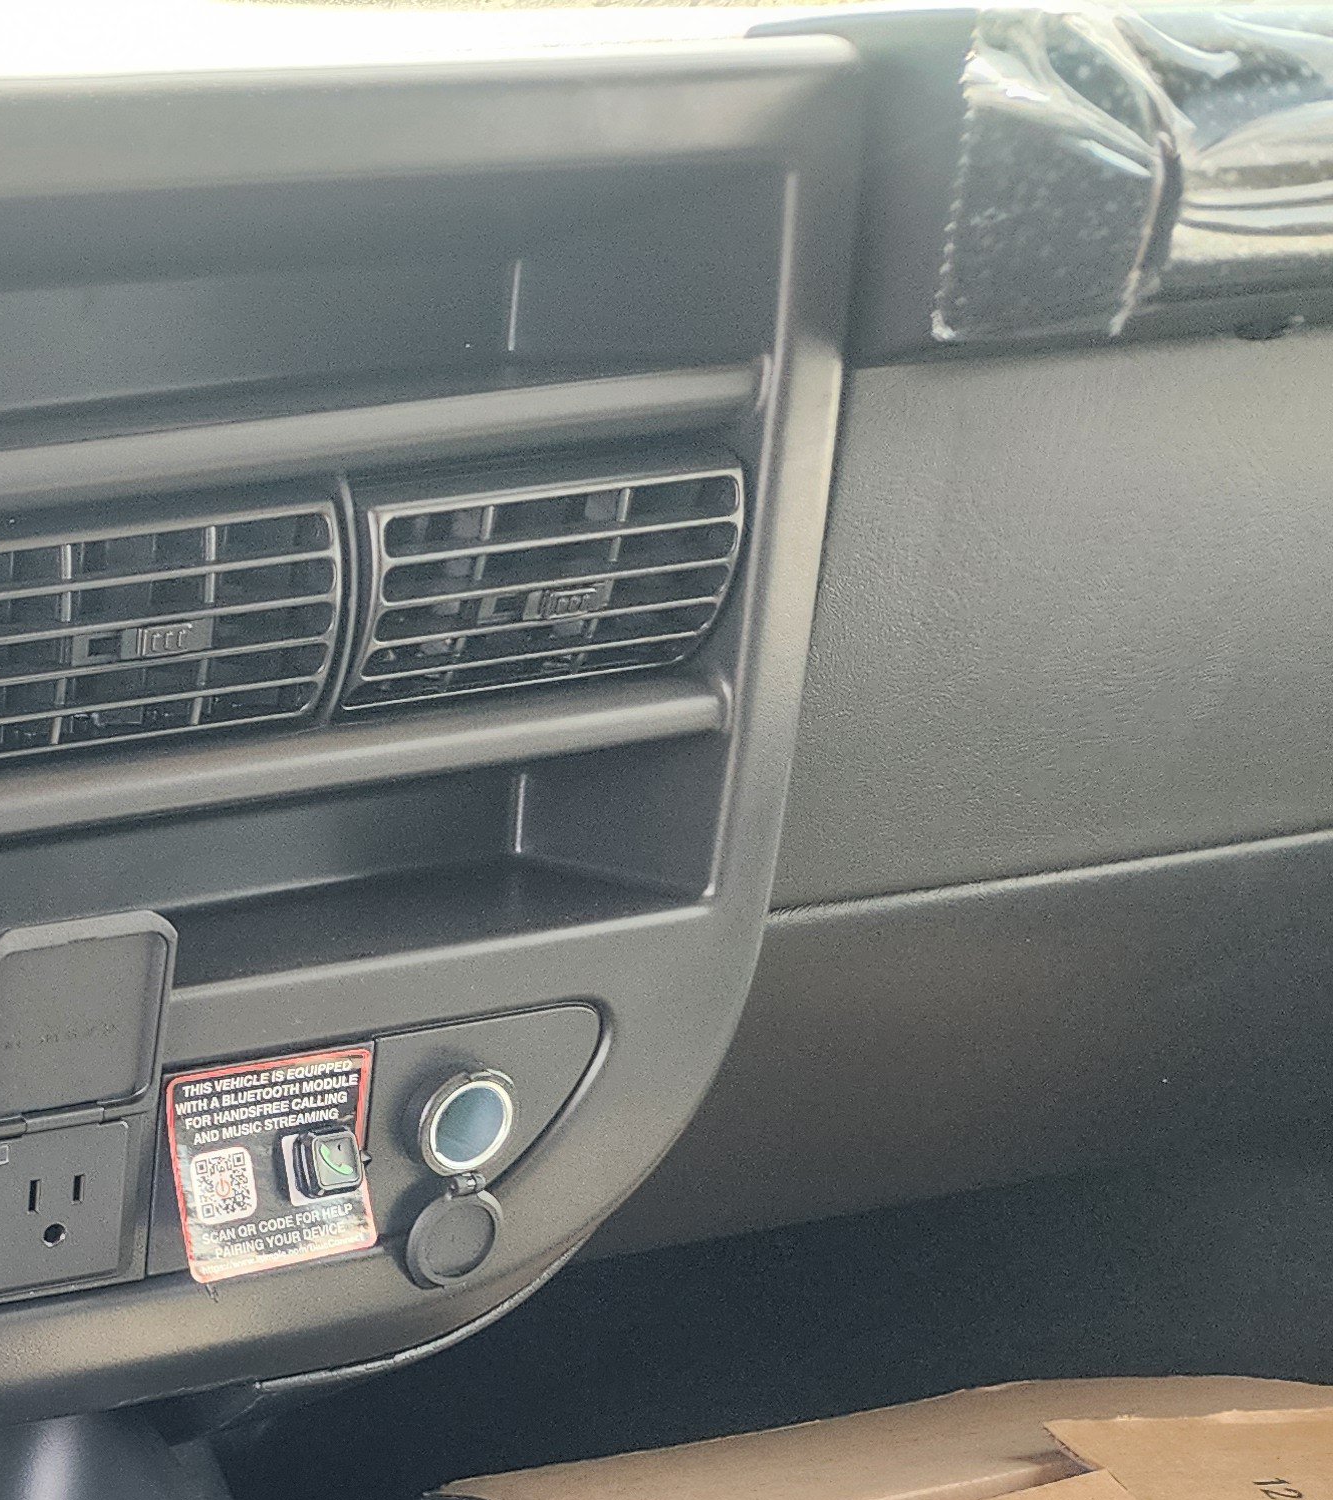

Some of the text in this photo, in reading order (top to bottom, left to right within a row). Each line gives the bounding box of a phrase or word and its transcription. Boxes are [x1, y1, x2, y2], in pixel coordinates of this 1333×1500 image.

[175, 1074, 359, 1116] WITH A BLUETOOTH MODULE
[182, 1060, 353, 1098] THIS VEHICLE IS EQUIPPED
[185, 1091, 348, 1130] FOR HANDSFREE CALLING
[193, 1108, 339, 1146] AND MUSIC STREAMING
[202, 1202, 353, 1245] SCAN QR CODE FOR HELP
[214, 1221, 346, 1260] PAIRING YOUR DEVICE
